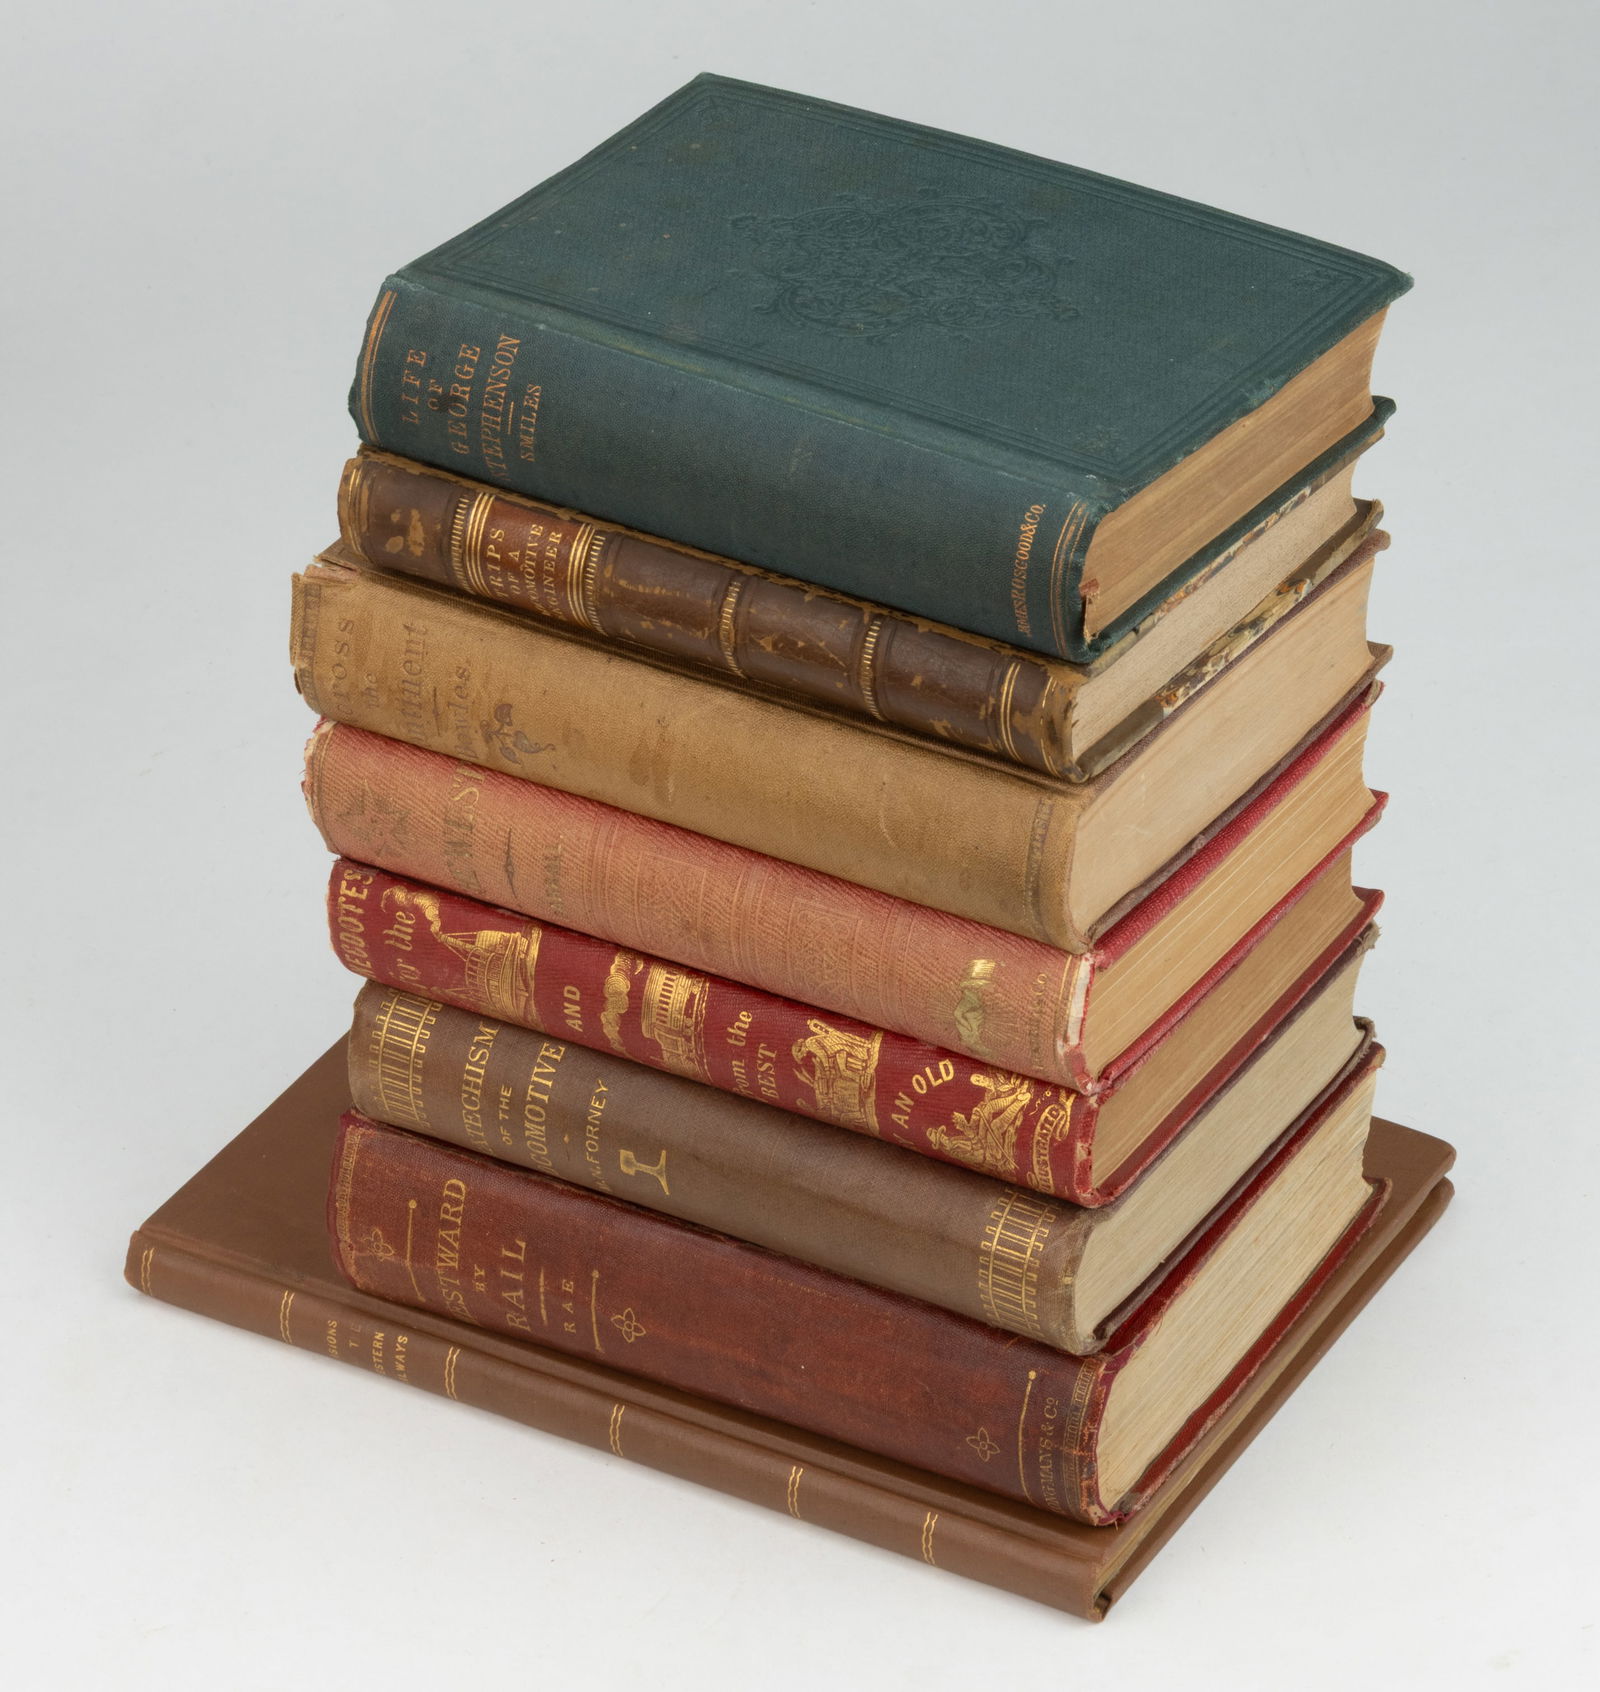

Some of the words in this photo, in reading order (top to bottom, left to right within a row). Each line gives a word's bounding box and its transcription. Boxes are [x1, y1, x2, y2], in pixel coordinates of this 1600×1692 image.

[401, 349, 427, 425] LIFE
[427, 378, 443, 411] OF
[447, 343, 481, 455] GEORGE
[520, 383, 543, 463] SMILES
[486, 528, 509, 599] TRIPS
[506, 572, 522, 595] OF
[508, 550, 521, 562] A
[338, 868, 377, 978] NECDOTES
[382, 911, 416, 952] the
[563, 984, 584, 1033] AND
[726, 1010, 753, 1047] the
[756, 1042, 780, 1099] BEST
[891, 1091, 915, 1129] AN
[912, 1059, 955, 1095] OLD
[498, 1084, 513, 1120] THE
[524, 1042, 566, 1175] OCOMOTIVE
[499, 1127, 513, 1145] OF
[436, 1177, 476, 1321] ESTWARD
[474, 1264, 486, 1293] BY
[501, 1239, 531, 1332] RAIL
[563, 1278, 577, 1335] RAE
